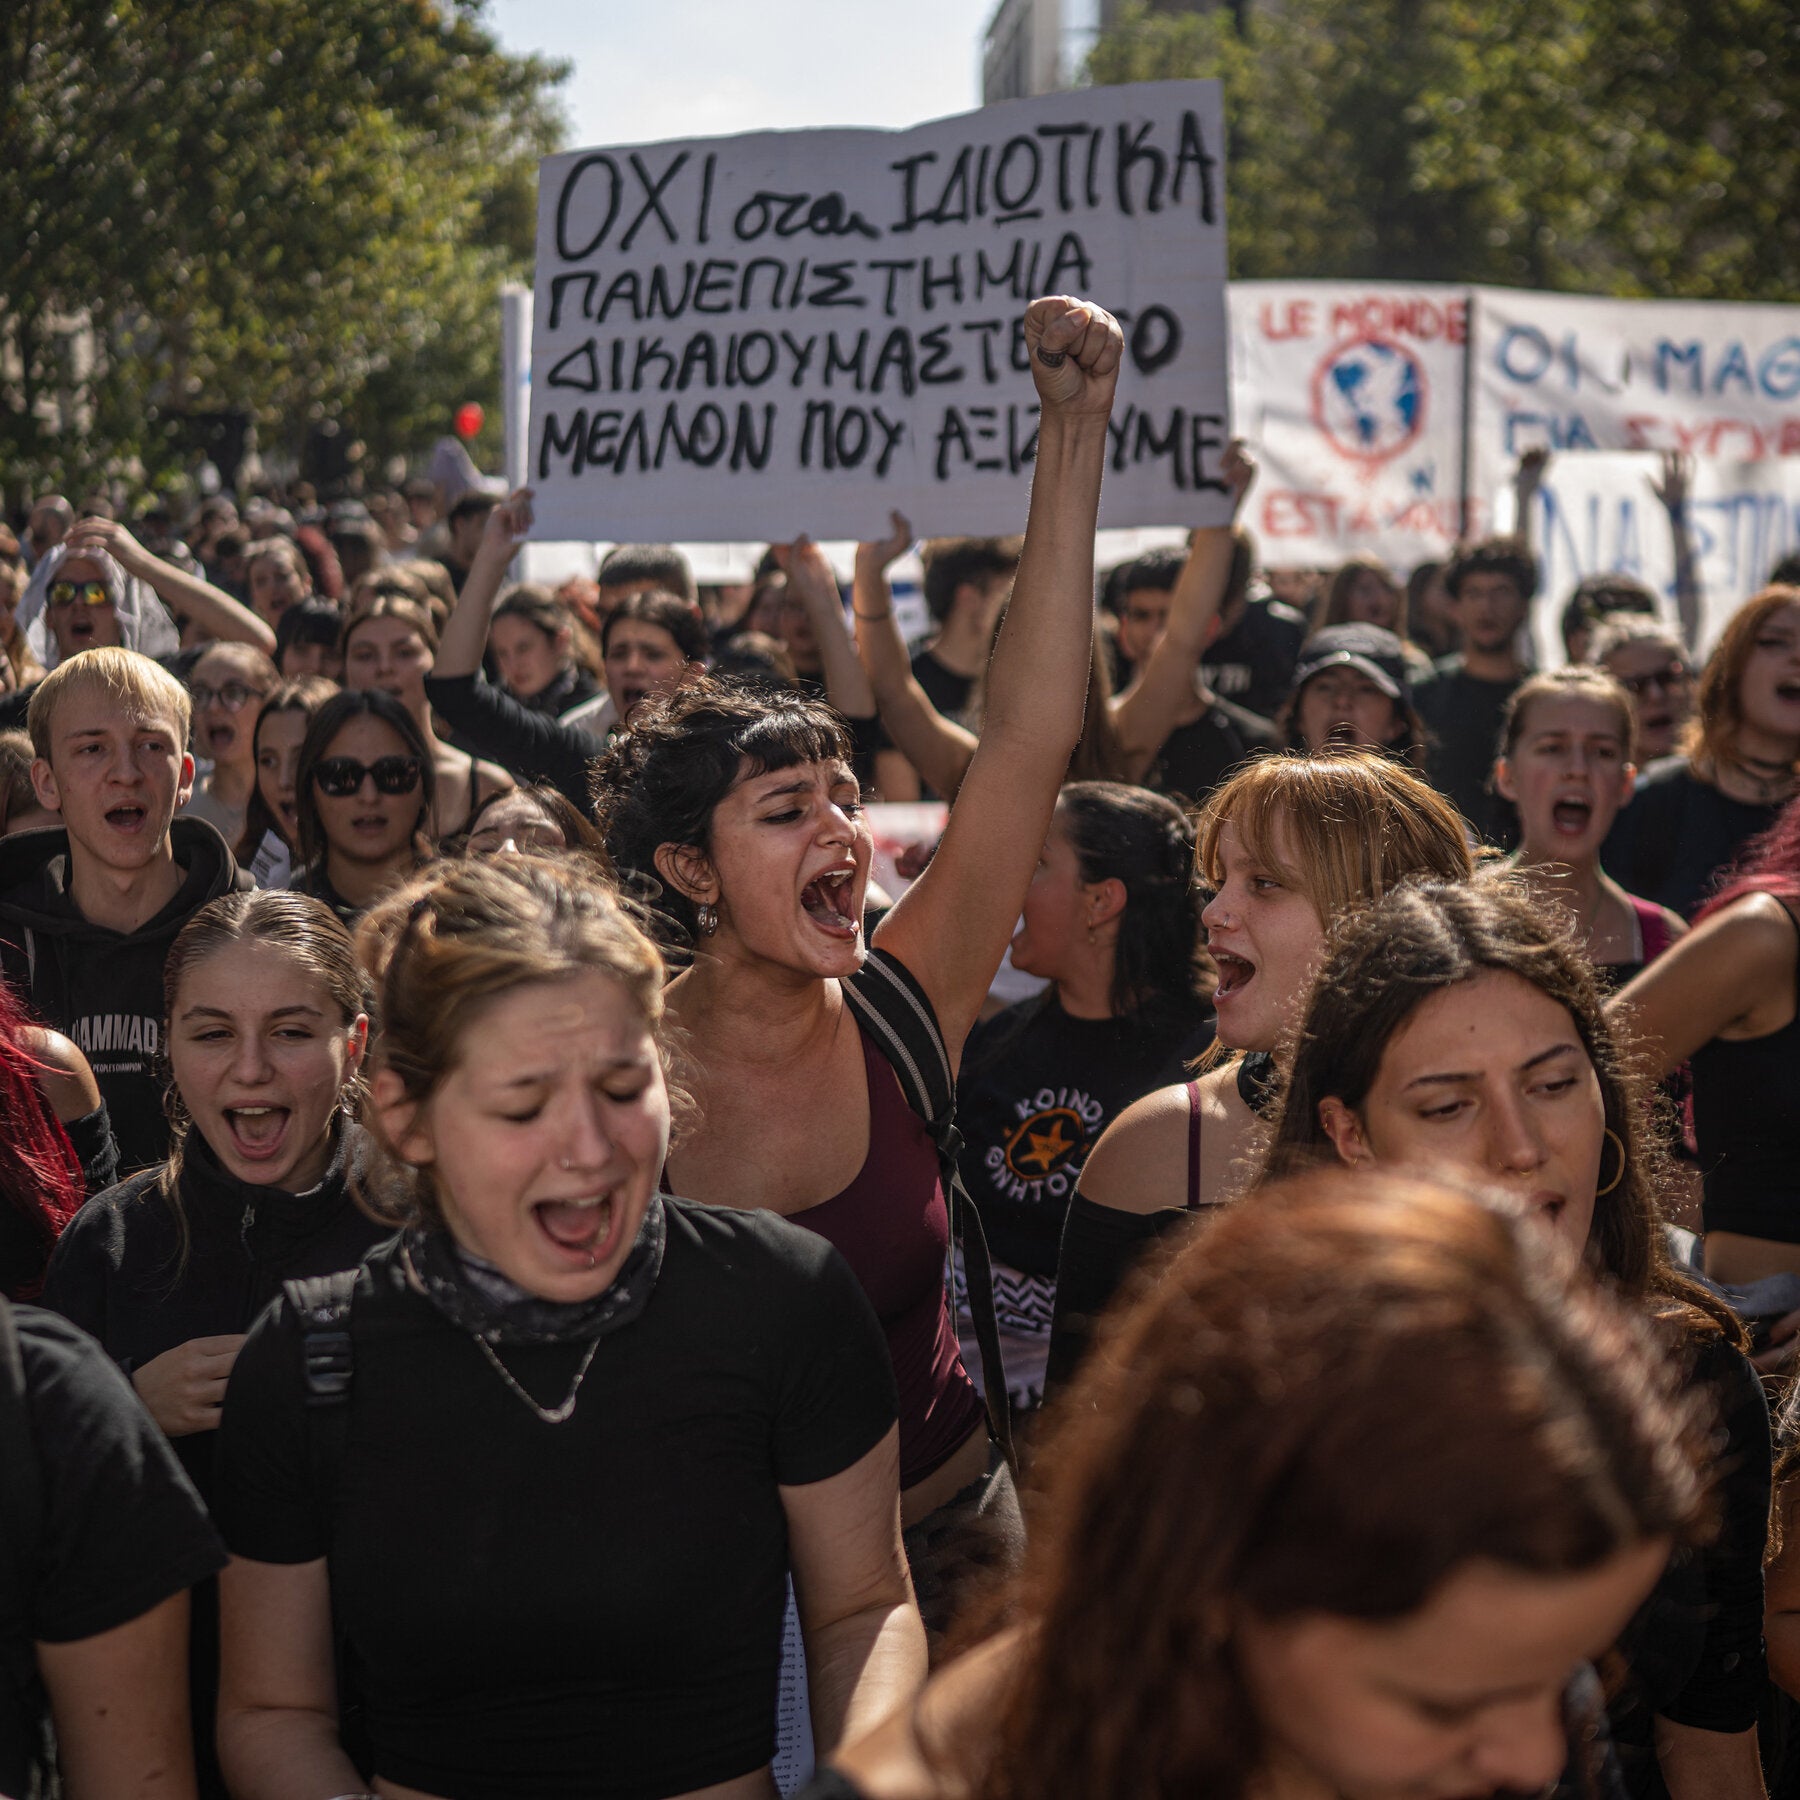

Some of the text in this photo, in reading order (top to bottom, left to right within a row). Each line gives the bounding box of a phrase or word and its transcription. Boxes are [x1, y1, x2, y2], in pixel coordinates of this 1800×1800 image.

[555, 151, 715, 262] ΟΧΙ
[547, 231, 1093, 330] ΠΑΝΕΠΙΣΤΗΜΙΑ
[1111, 304, 1183, 376] Ο
[537, 401, 1231, 495] ΜΕΛΛΟΝ ΠΟΥ ΑΞΙΖΥΜΕ
